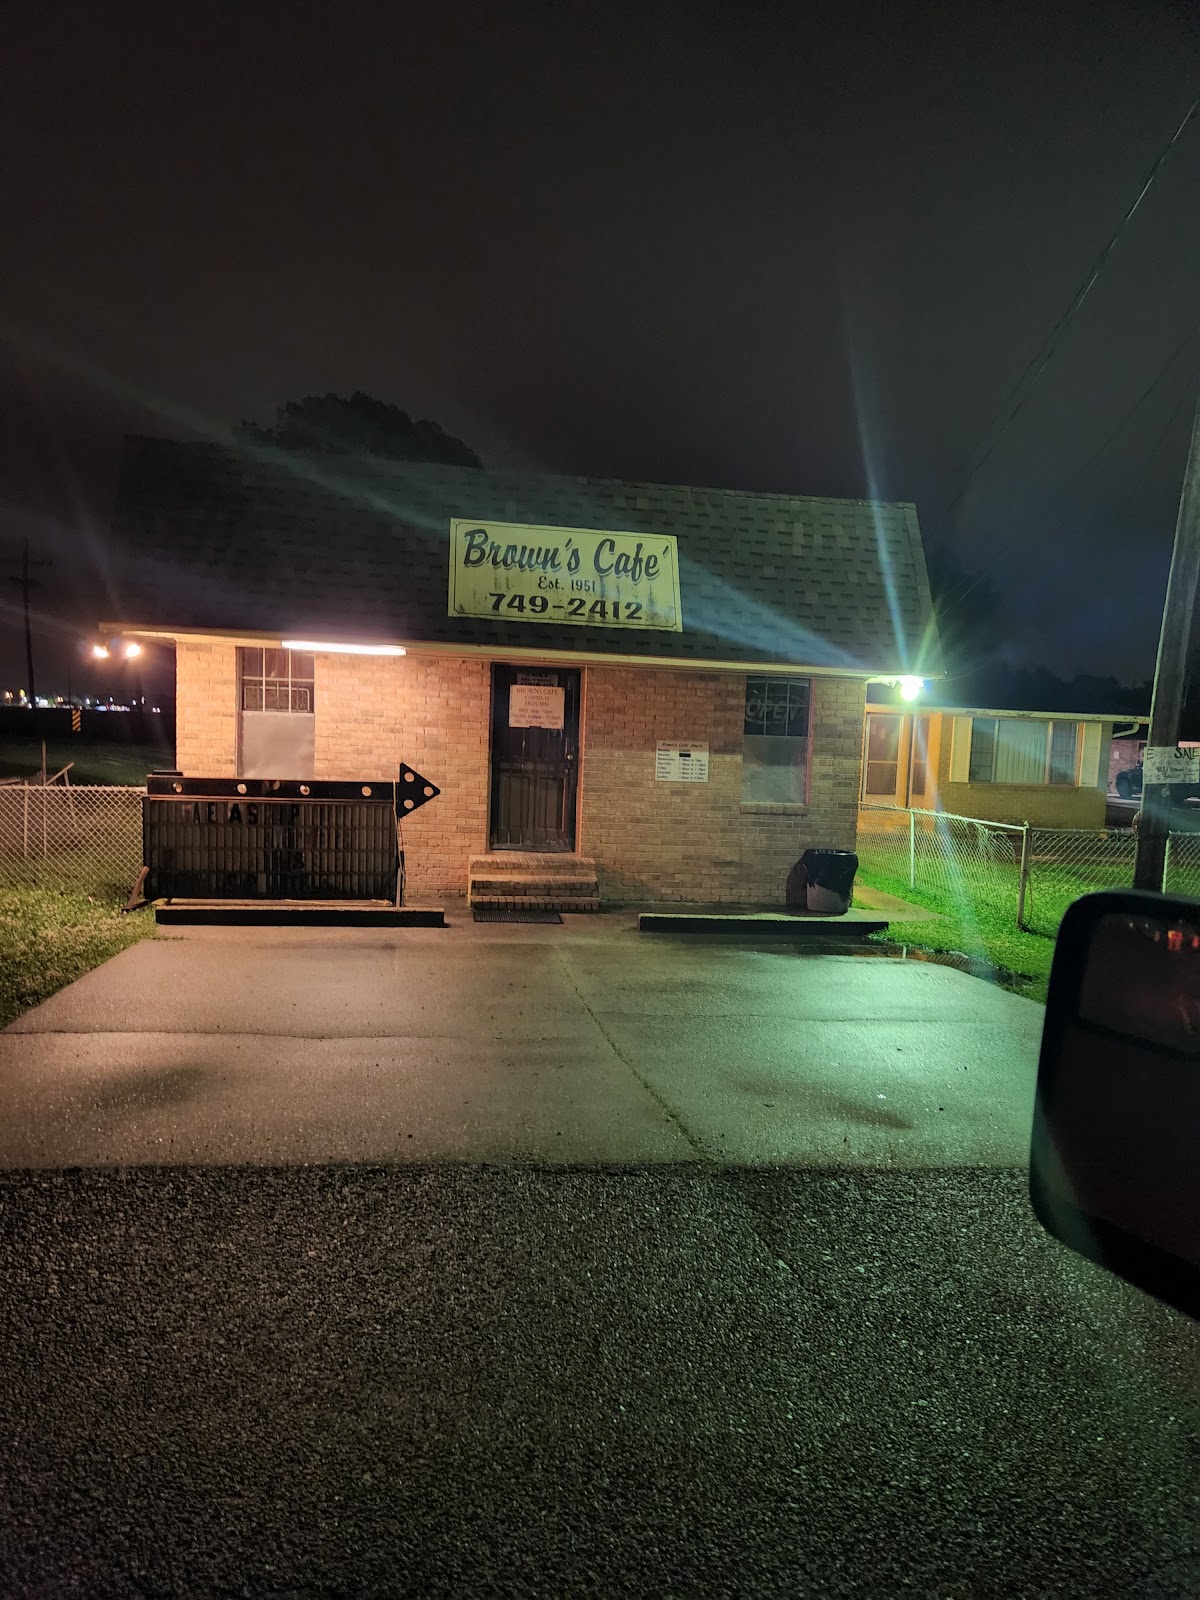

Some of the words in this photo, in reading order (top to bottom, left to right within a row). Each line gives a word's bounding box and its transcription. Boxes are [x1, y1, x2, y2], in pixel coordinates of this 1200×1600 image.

[463, 528, 581, 575] Brown's
[537, 576, 565, 591] Est.
[570, 579, 596, 593] 1951
[489, 592, 643, 620] 749-2412
[745, 698, 802, 721] OPEN
[1174, 747, 1200, 760] SALE
